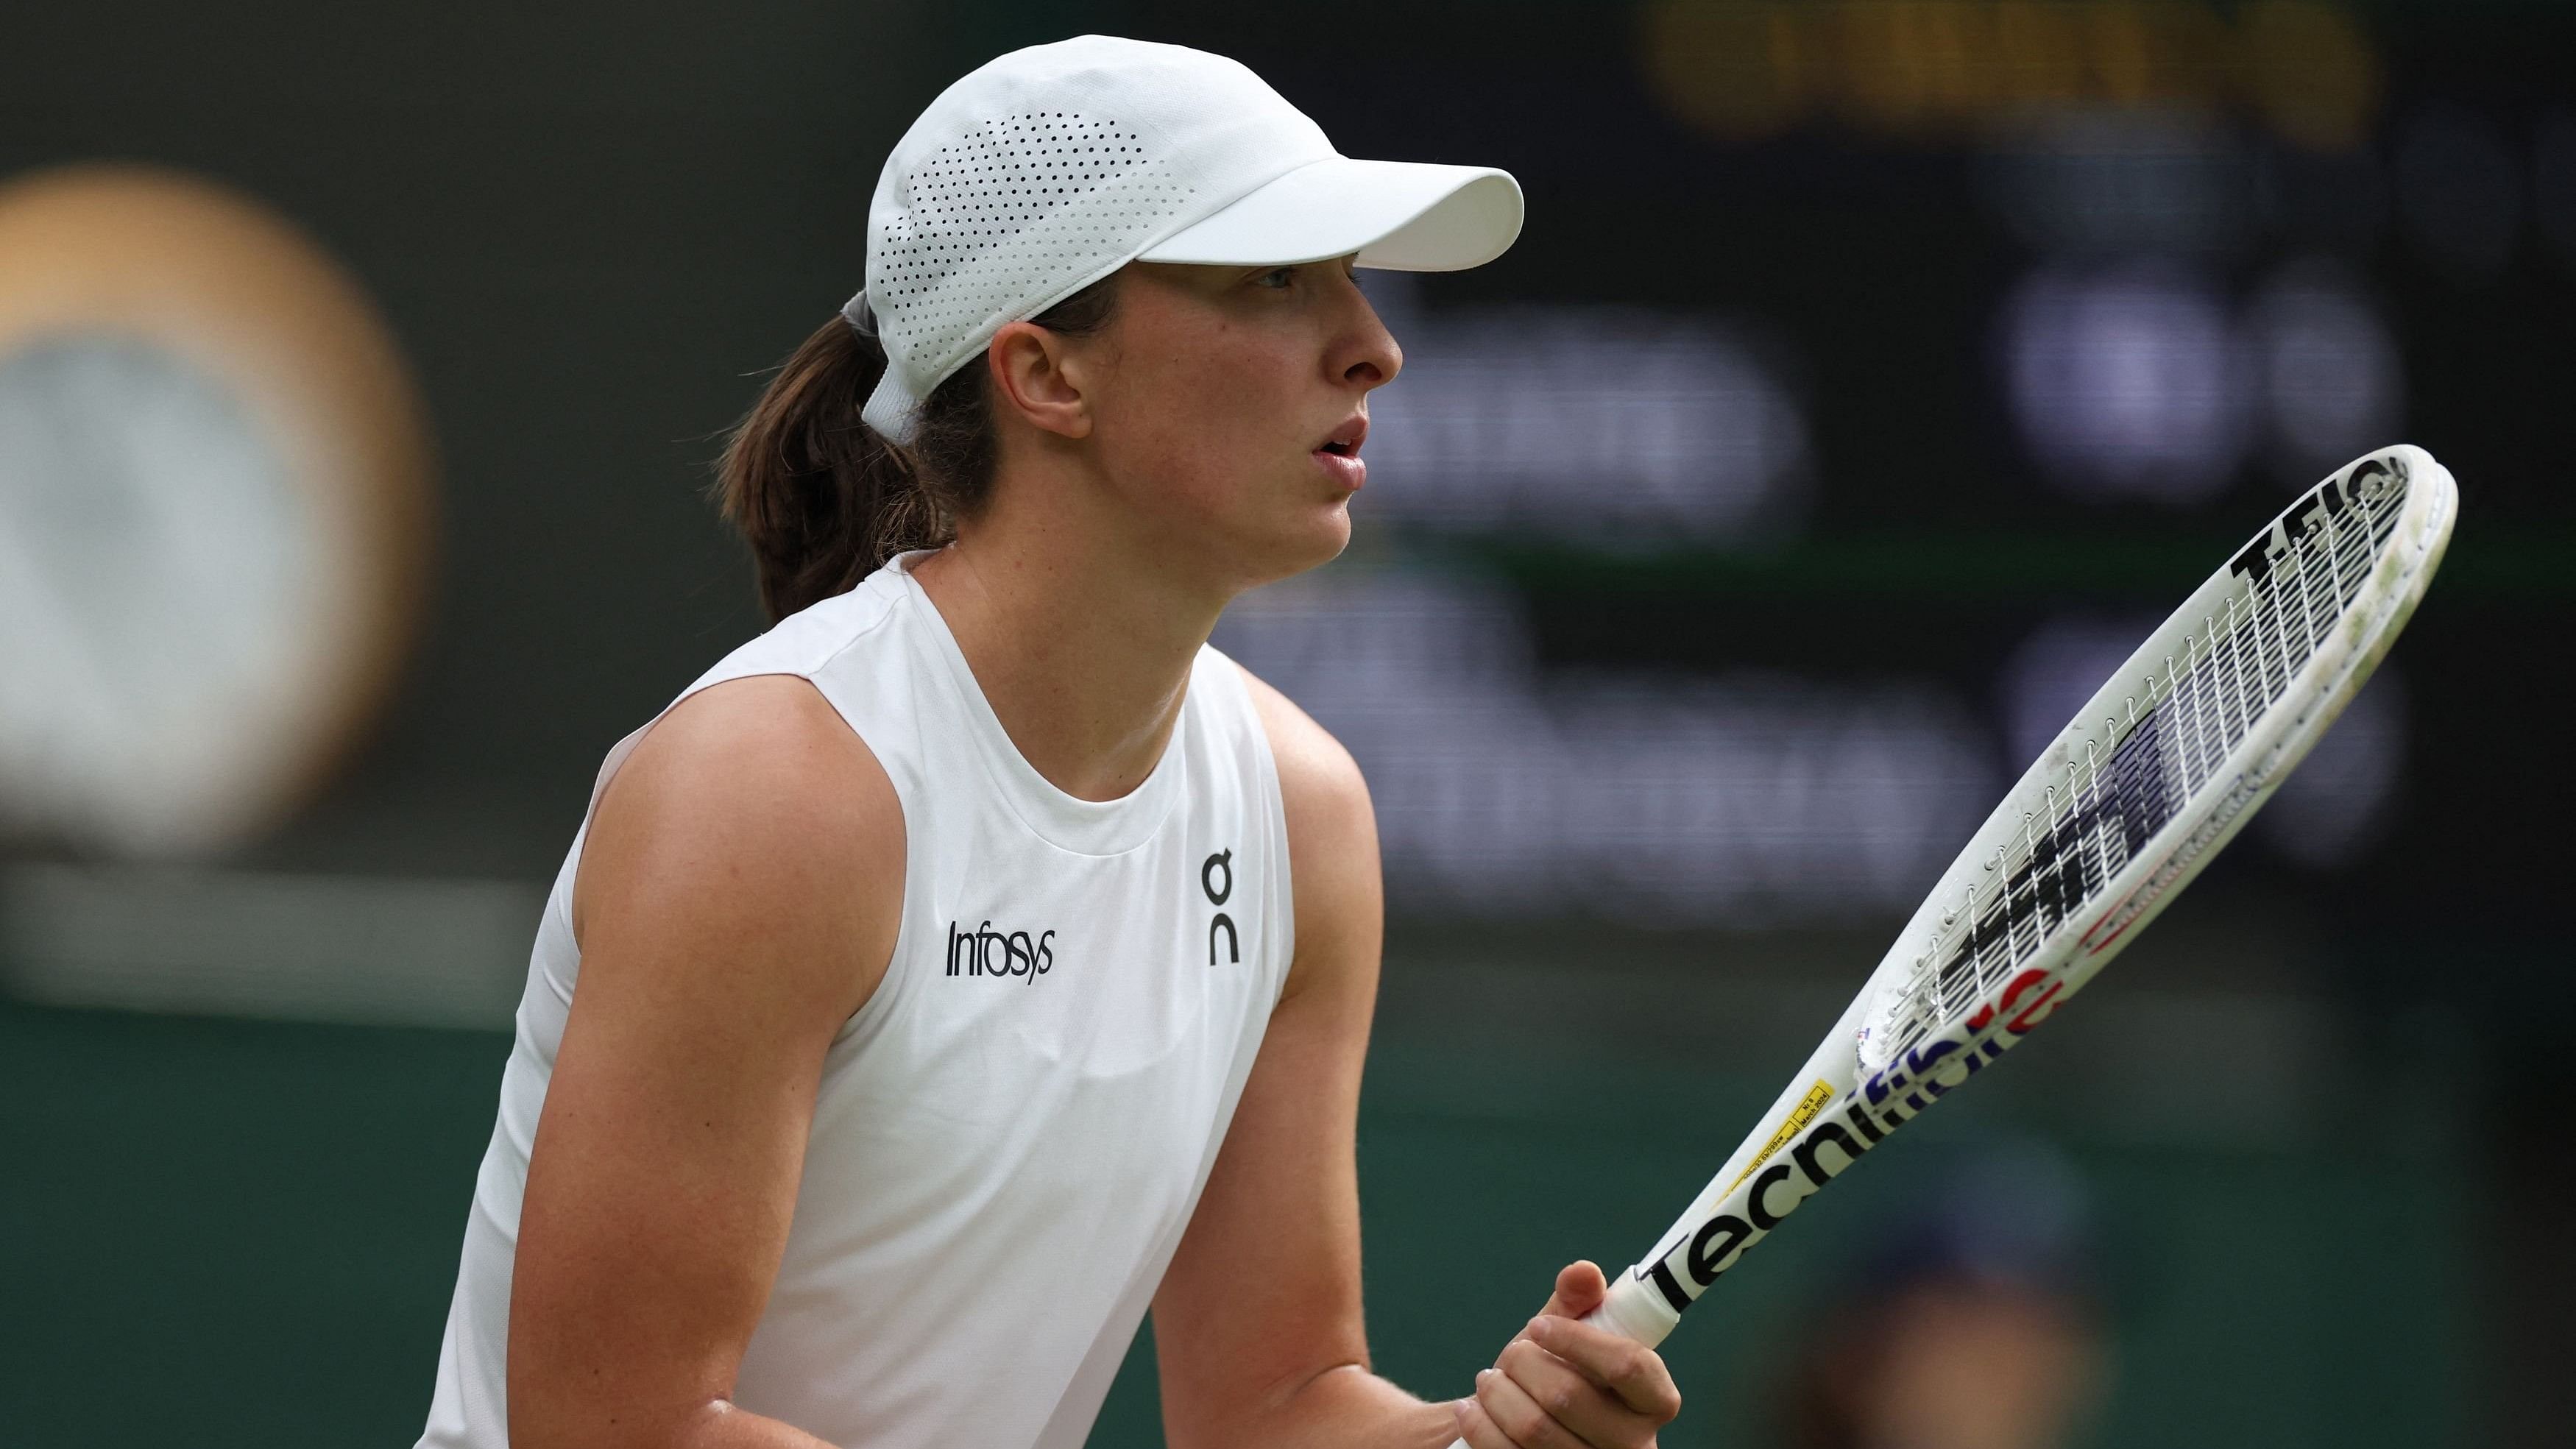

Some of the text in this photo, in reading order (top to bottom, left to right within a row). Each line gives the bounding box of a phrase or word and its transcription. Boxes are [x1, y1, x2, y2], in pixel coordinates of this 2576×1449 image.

[946, 920, 1055, 985] Infosys
[1801, 1094, 1827, 1125] March 2024
